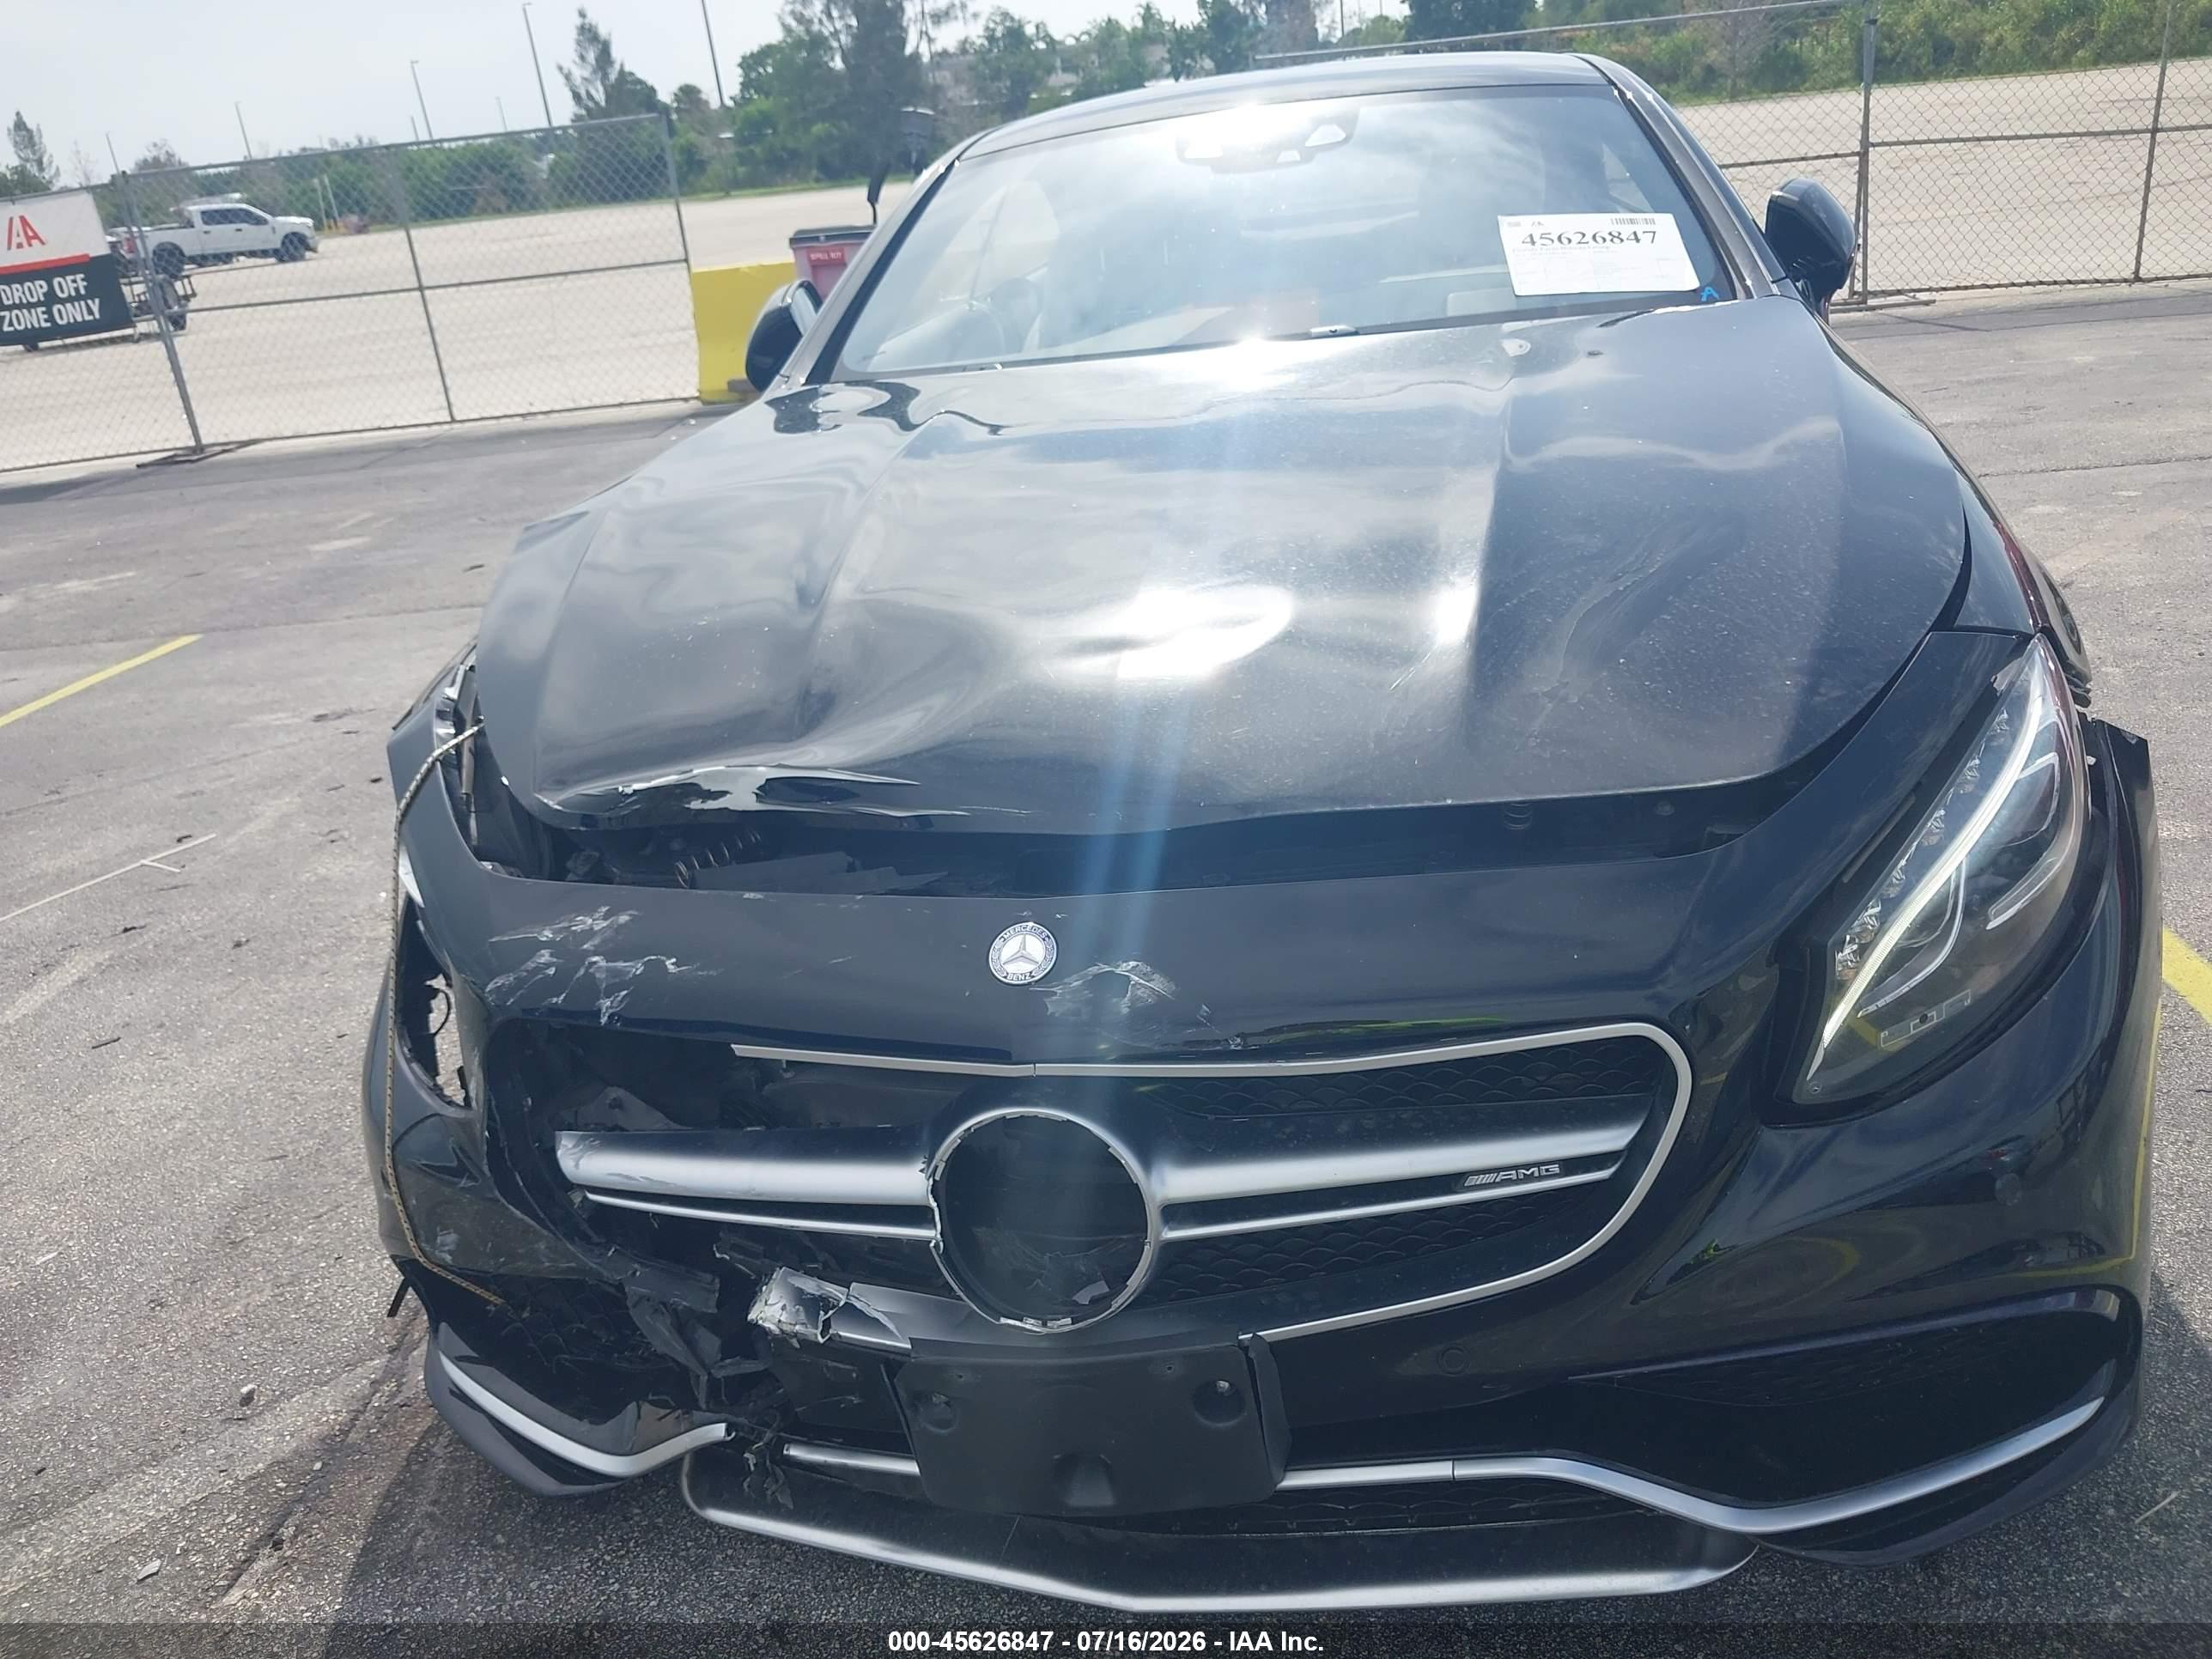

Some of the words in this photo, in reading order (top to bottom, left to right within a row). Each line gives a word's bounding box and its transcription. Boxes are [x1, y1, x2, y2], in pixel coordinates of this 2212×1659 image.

[1522, 230, 1656, 247] 45626847
[0, 280, 48, 306] DROP
[52, 273, 88, 299] OFF
[0, 307, 52, 332] ZONE
[52, 298, 100, 325] ONLY
[1002, 924, 1048, 940] MERCEDES
[1006, 972, 1032, 981] BENZ
